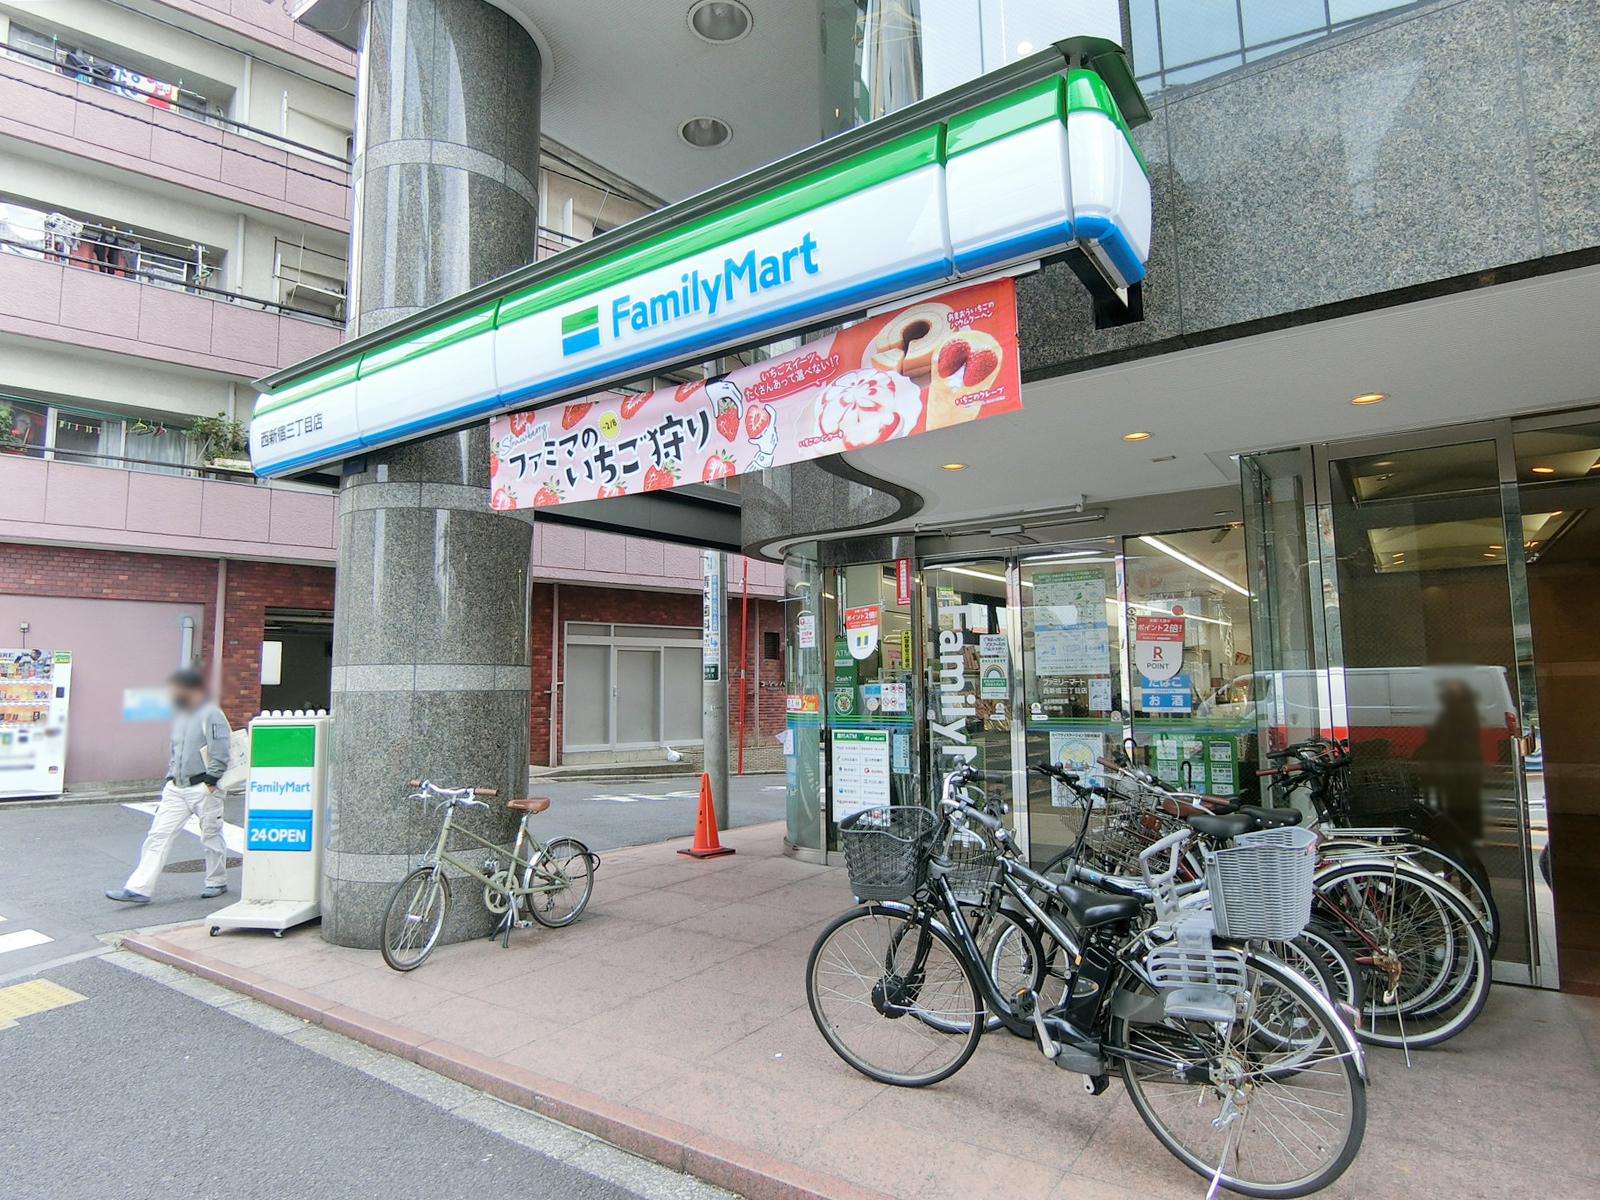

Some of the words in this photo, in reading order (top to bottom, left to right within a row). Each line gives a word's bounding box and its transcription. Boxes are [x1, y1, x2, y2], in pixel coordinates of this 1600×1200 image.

[612, 232, 820, 339] FamilyMart
[260, 412, 323, 448] 西新宿三丁目店
[509, 427, 599, 479] ファミマの
[566, 410, 710, 488] いちご狩り
[1138, 624, 1183, 632] ポイント2倍!
[1147, 662, 1170, 670] POINT
[1042, 678, 1086, 686] ファミリーマート
[250, 782, 311, 796] FamilyMart
